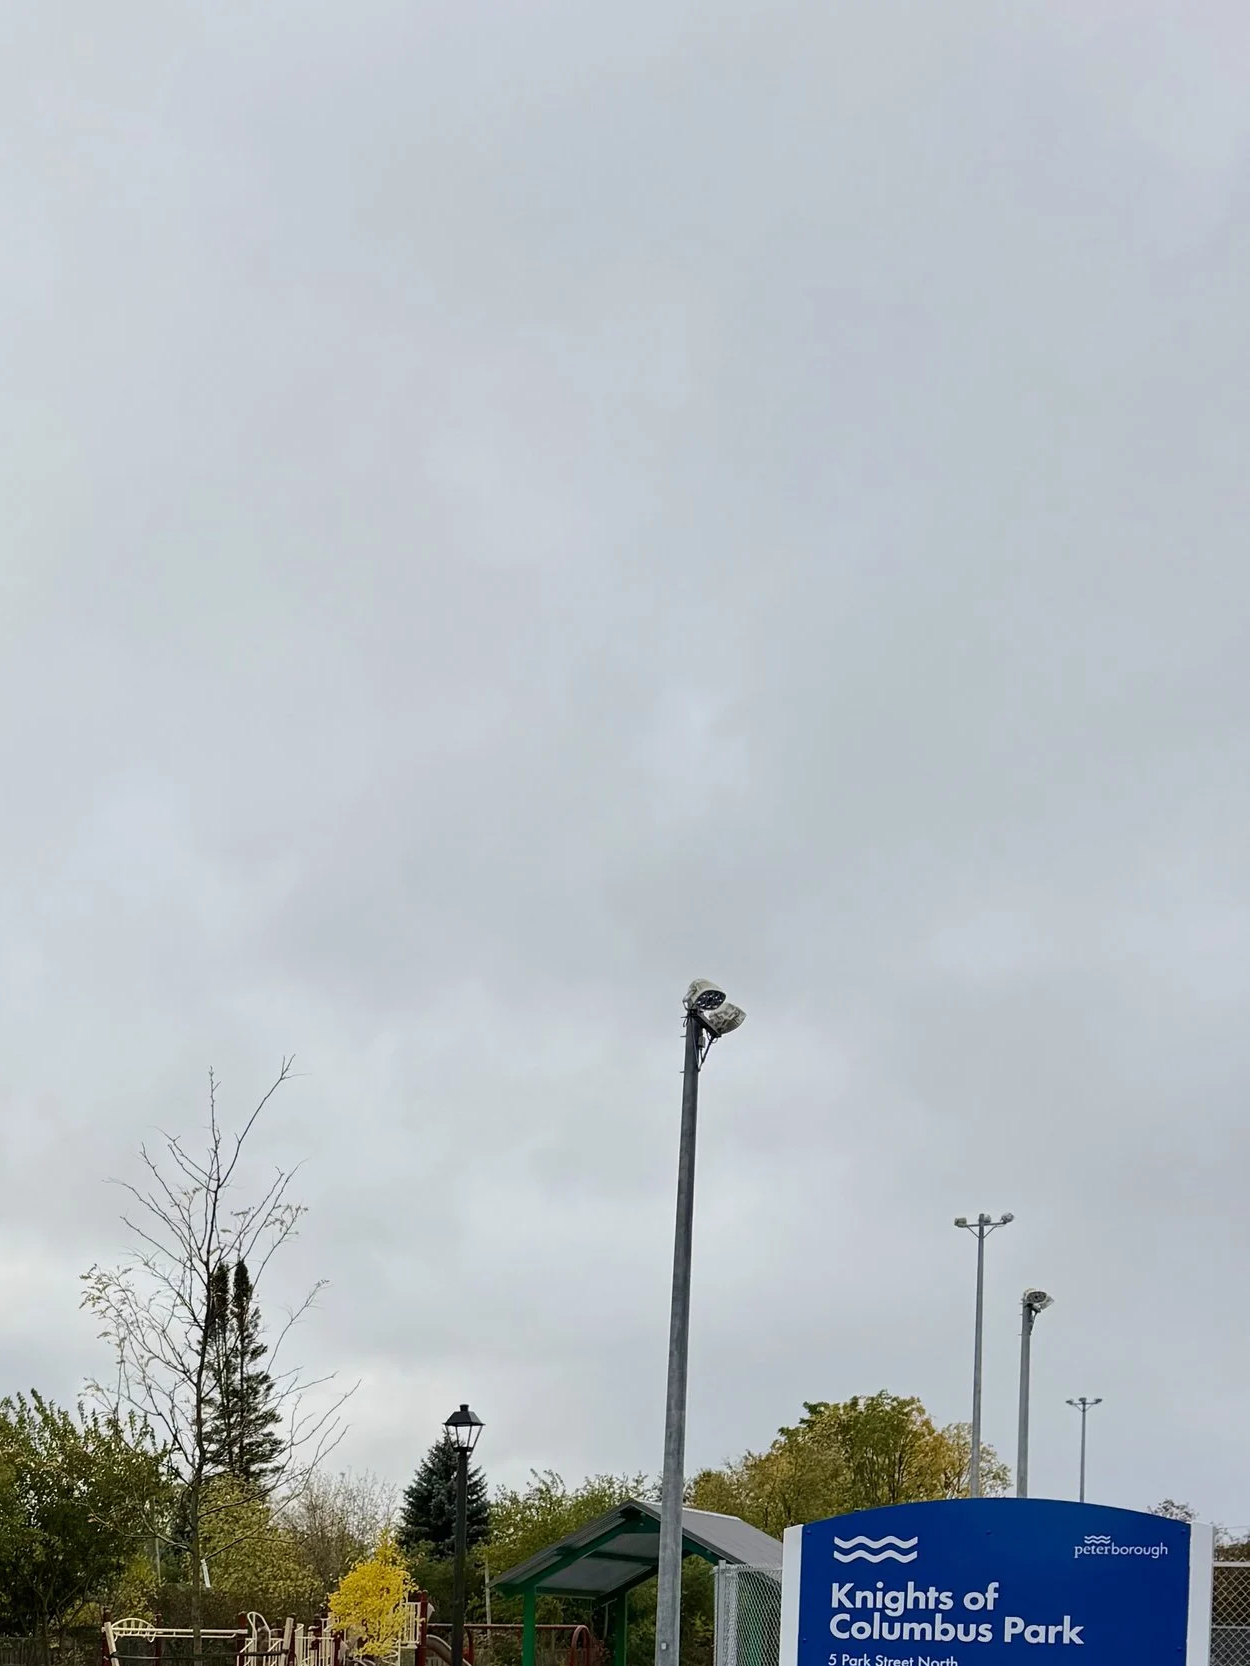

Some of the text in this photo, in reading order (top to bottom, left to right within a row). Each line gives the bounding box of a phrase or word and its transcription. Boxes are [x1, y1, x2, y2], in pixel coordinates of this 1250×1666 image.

[1074, 1542, 1168, 1559] peterborough
[831, 1581, 999, 1617] Knights of
[829, 1612, 1085, 1645] Columbus Park
[828, 1653, 837, 1666] 5
[842, 1653, 871, 1666] Park
